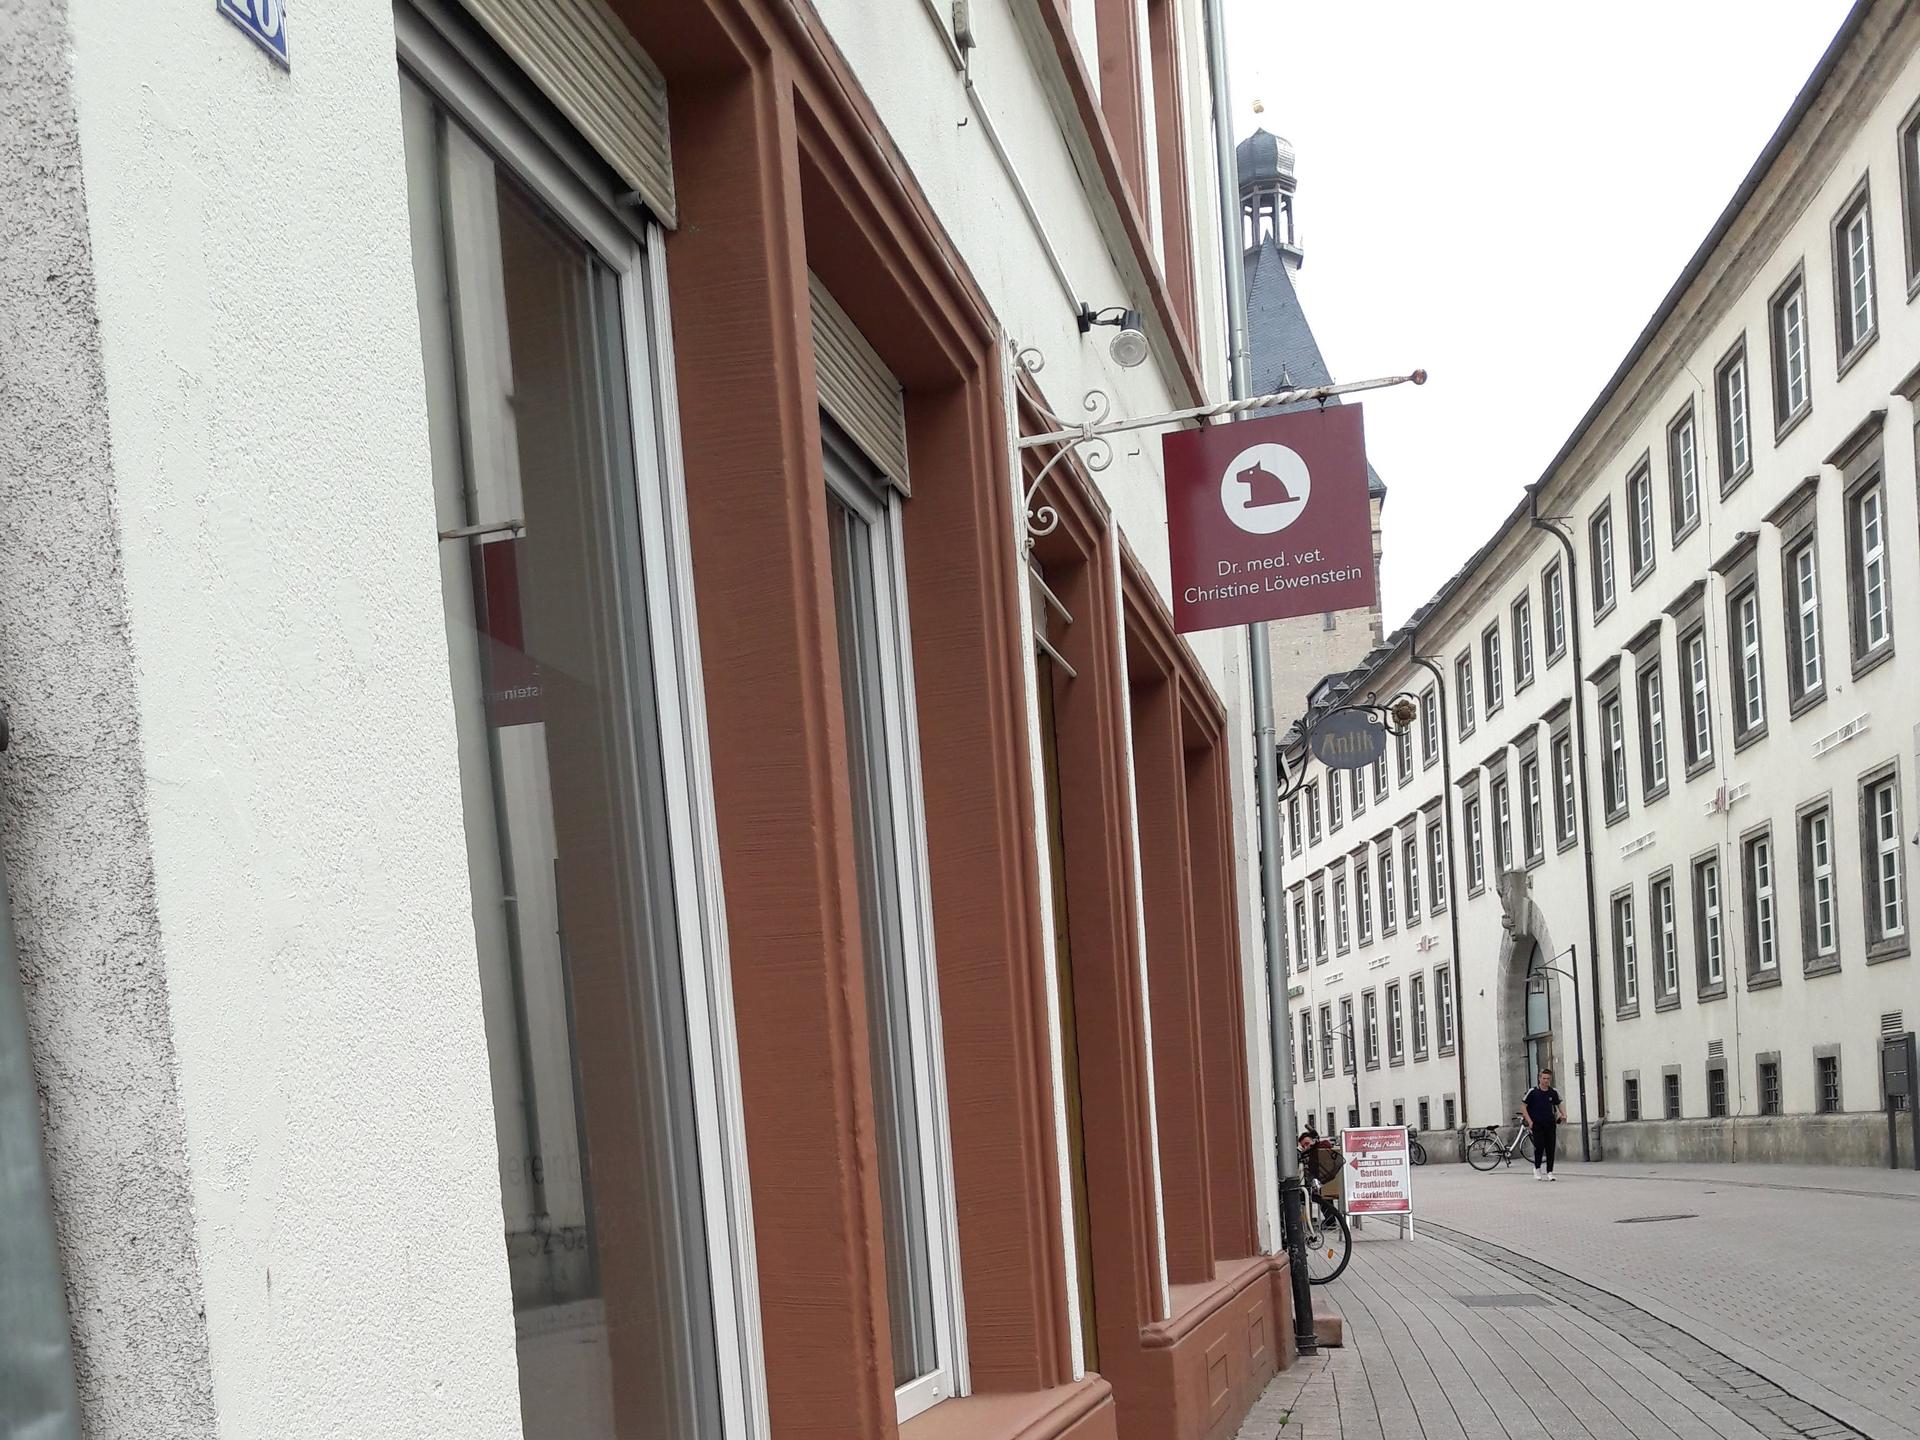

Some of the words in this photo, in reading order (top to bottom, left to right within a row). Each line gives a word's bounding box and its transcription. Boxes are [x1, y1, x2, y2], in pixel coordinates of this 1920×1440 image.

[1217, 559, 1242, 577] Dr.
[1246, 551, 1290, 572] med.
[1294, 548, 1325, 565] vet.
[1184, 581, 1260, 604] Christine
[1265, 565, 1362, 592] Löwenstein
[1360, 1170, 1393, 1178] Gardinen
[1355, 1180, 1399, 1189] Brautkleider
